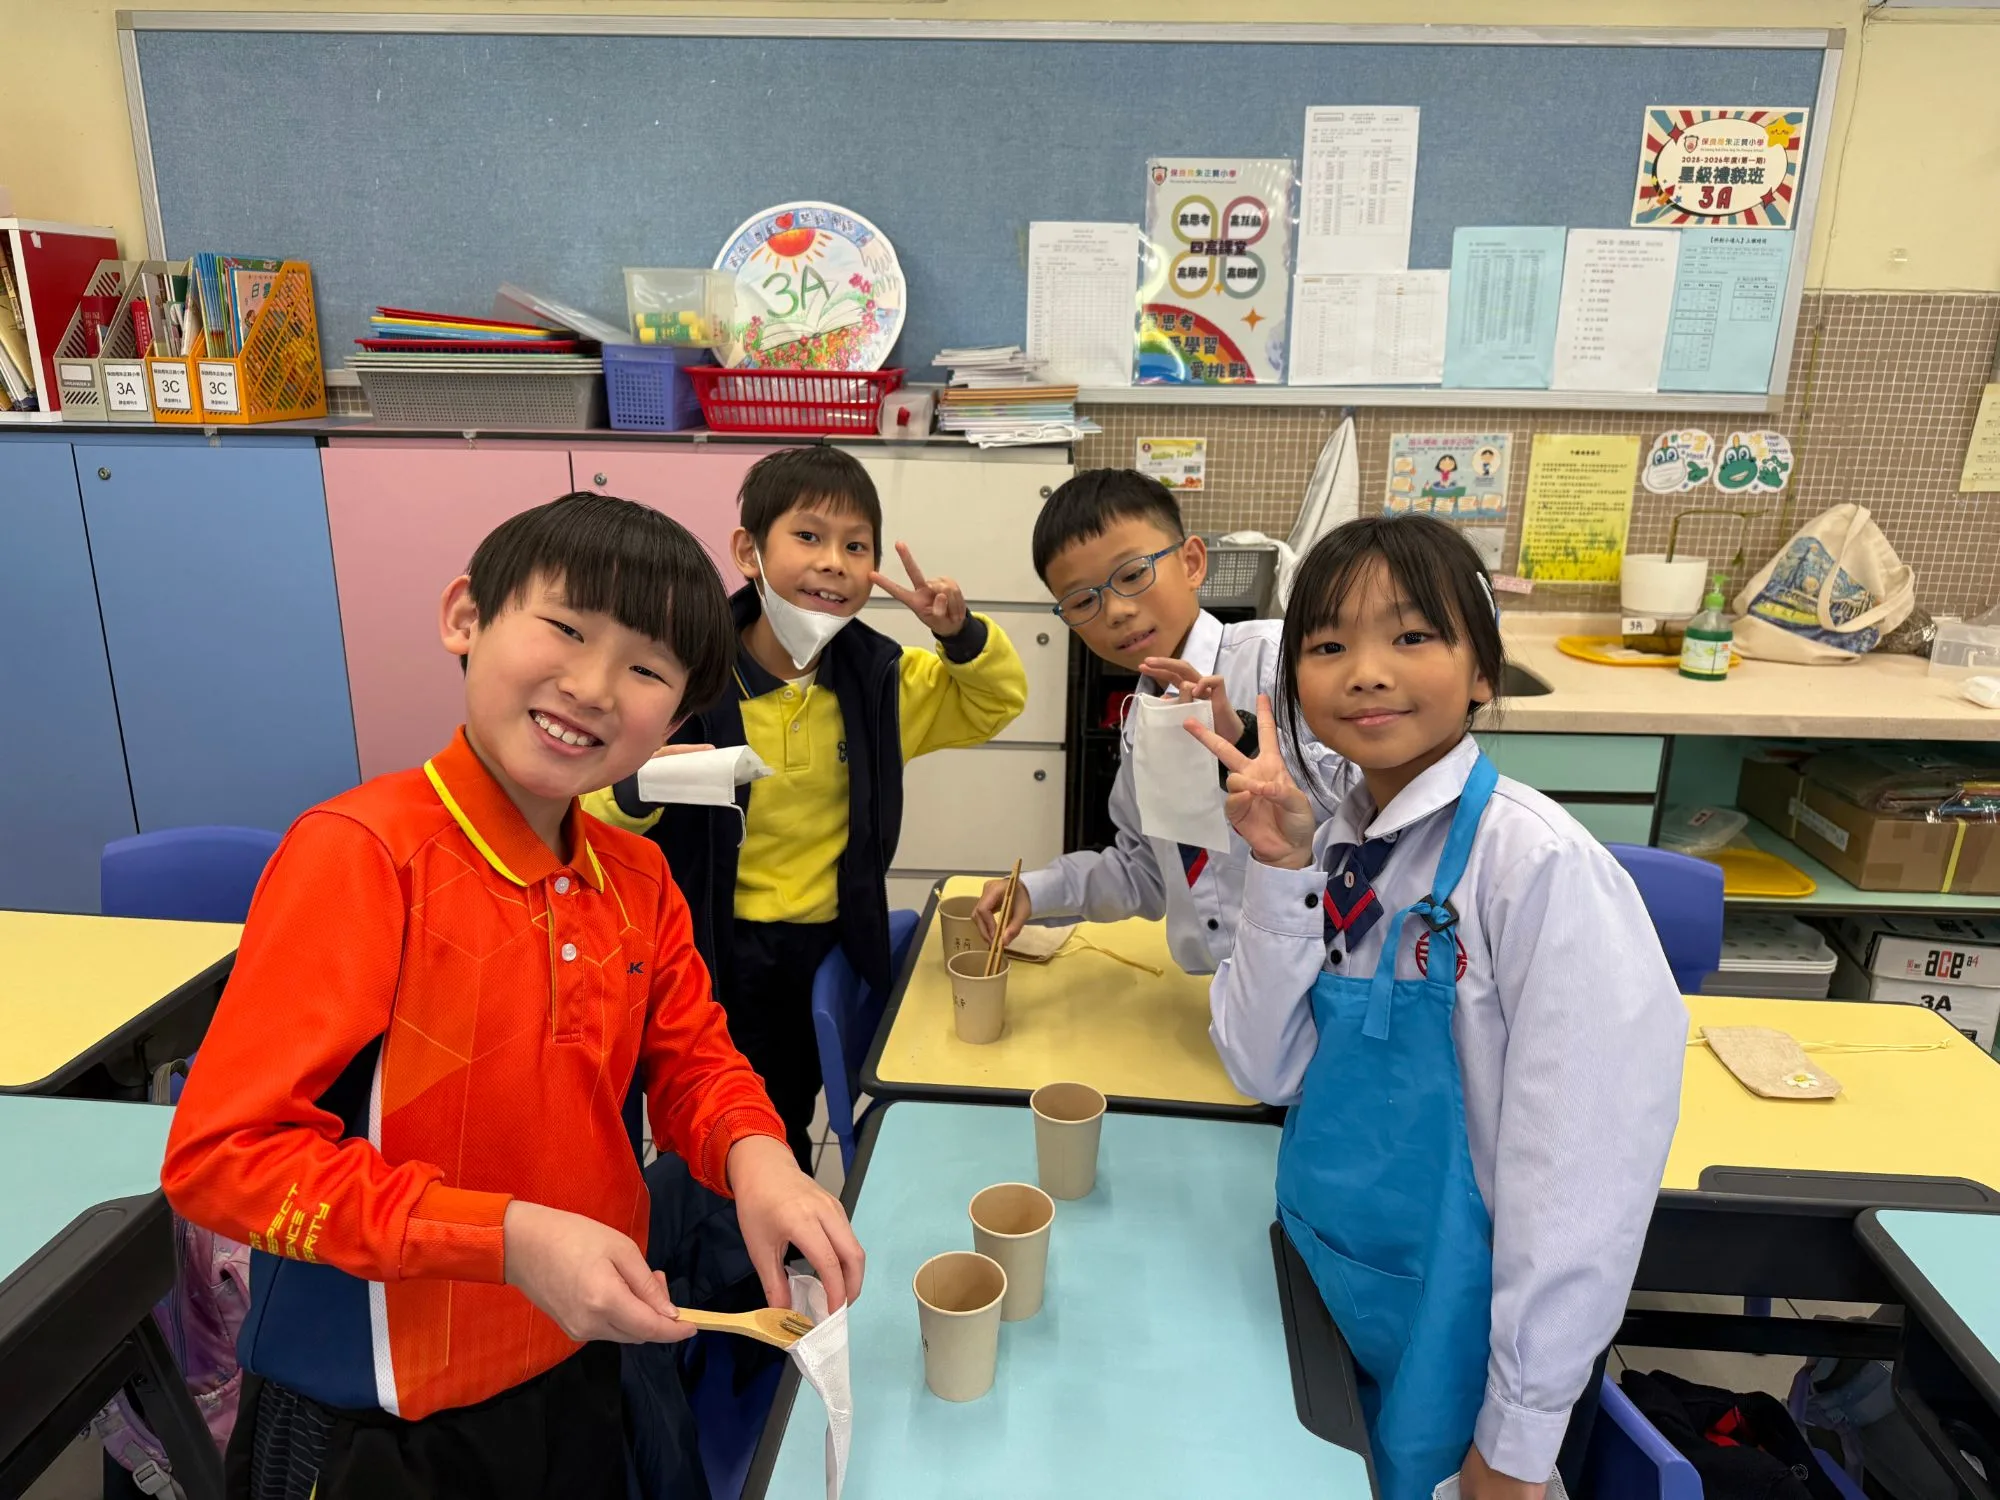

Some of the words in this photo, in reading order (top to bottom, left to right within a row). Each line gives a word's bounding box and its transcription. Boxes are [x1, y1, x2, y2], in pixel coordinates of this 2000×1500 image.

[1678, 166, 1765, 184] 星級禮貌班
[1698, 186, 1733, 209] 3A
[1179, 214, 1210, 226] 高思考
[1190, 240, 1248, 256] 四高課堂
[1177, 267, 1208, 279] 高展示
[762, 264, 831, 319] 3A
[1190, 361, 1247, 379] 愛挑戰
[116, 382, 136, 395] 3A
[162, 380, 180, 393] 3C
[209, 381, 228, 395] 3C
[1925, 950, 1965, 979] ace
[1967, 955, 1980, 968] a4
[1920, 995, 1952, 1012] 3A
